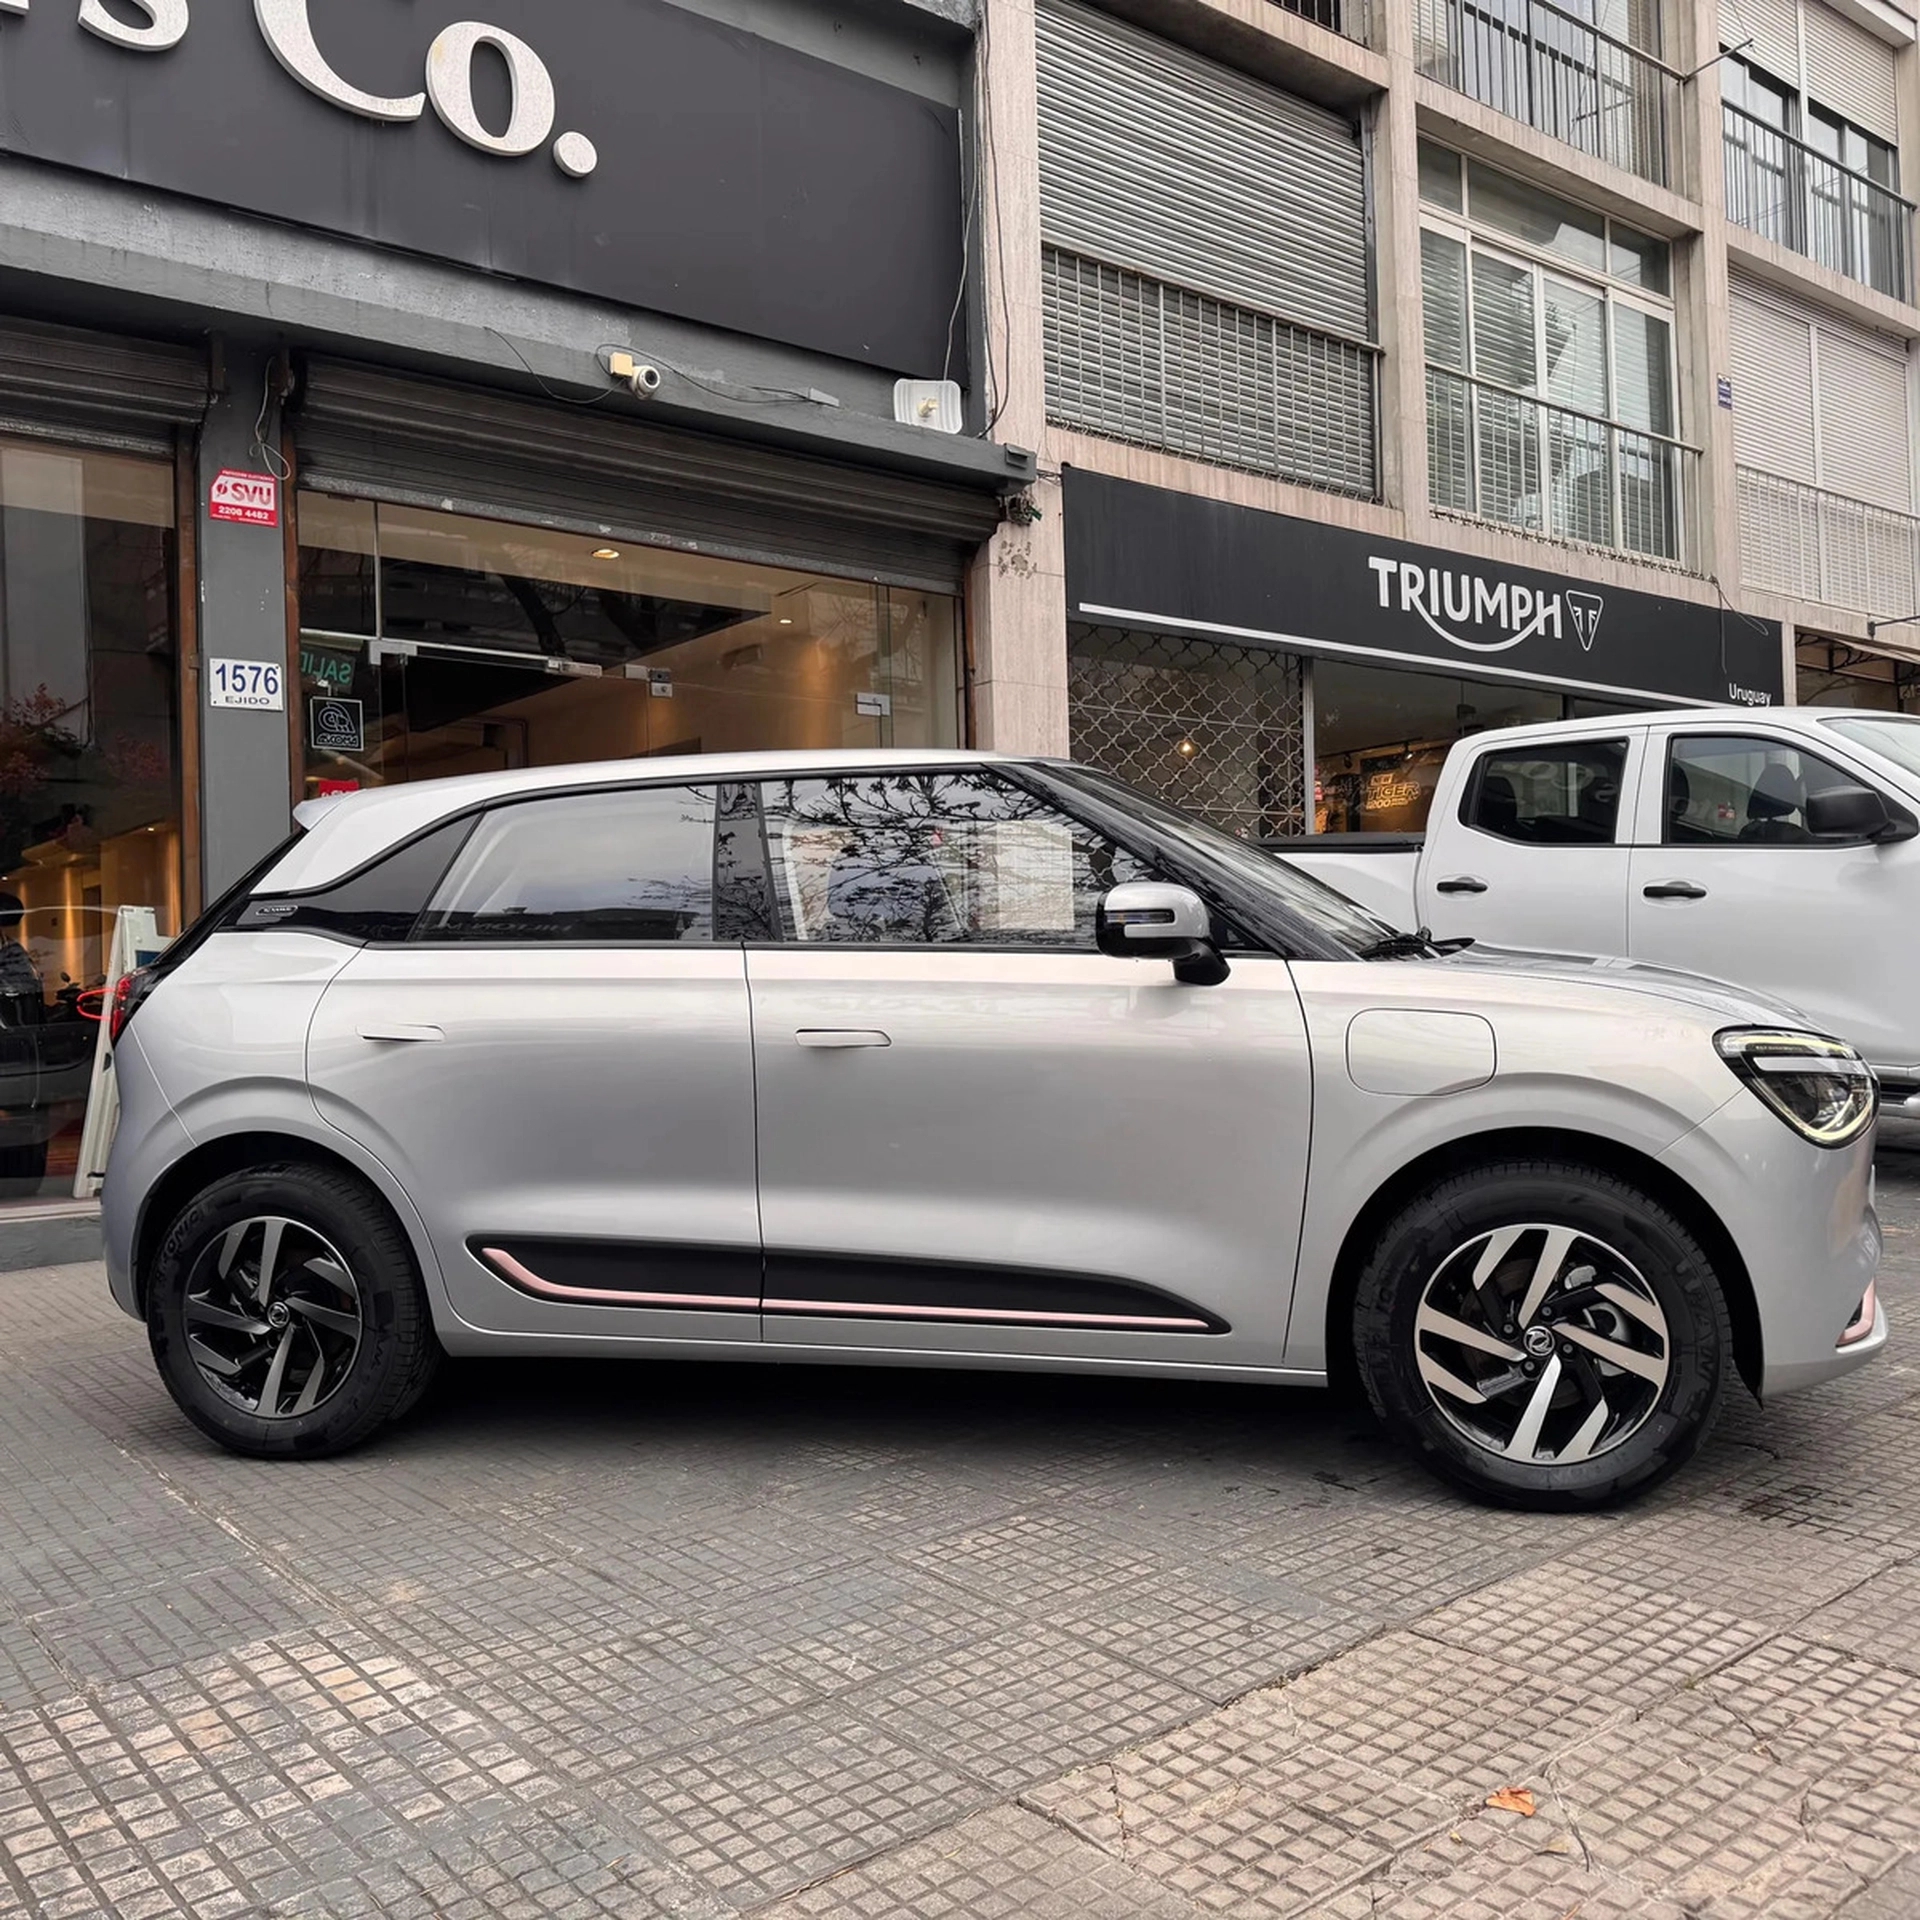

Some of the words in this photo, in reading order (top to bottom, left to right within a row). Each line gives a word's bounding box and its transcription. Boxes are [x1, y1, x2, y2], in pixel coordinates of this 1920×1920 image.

[253, 0, 598, 178] Co.
[231, 482, 271, 505] SVU
[1368, 556, 1562, 651] TRIUMPH
[215, 663, 278, 695] 1576
[225, 695, 270, 705] EJIDO
[1728, 682, 1771, 709] Uruguay
[1367, 782, 1419, 800] TIGER
